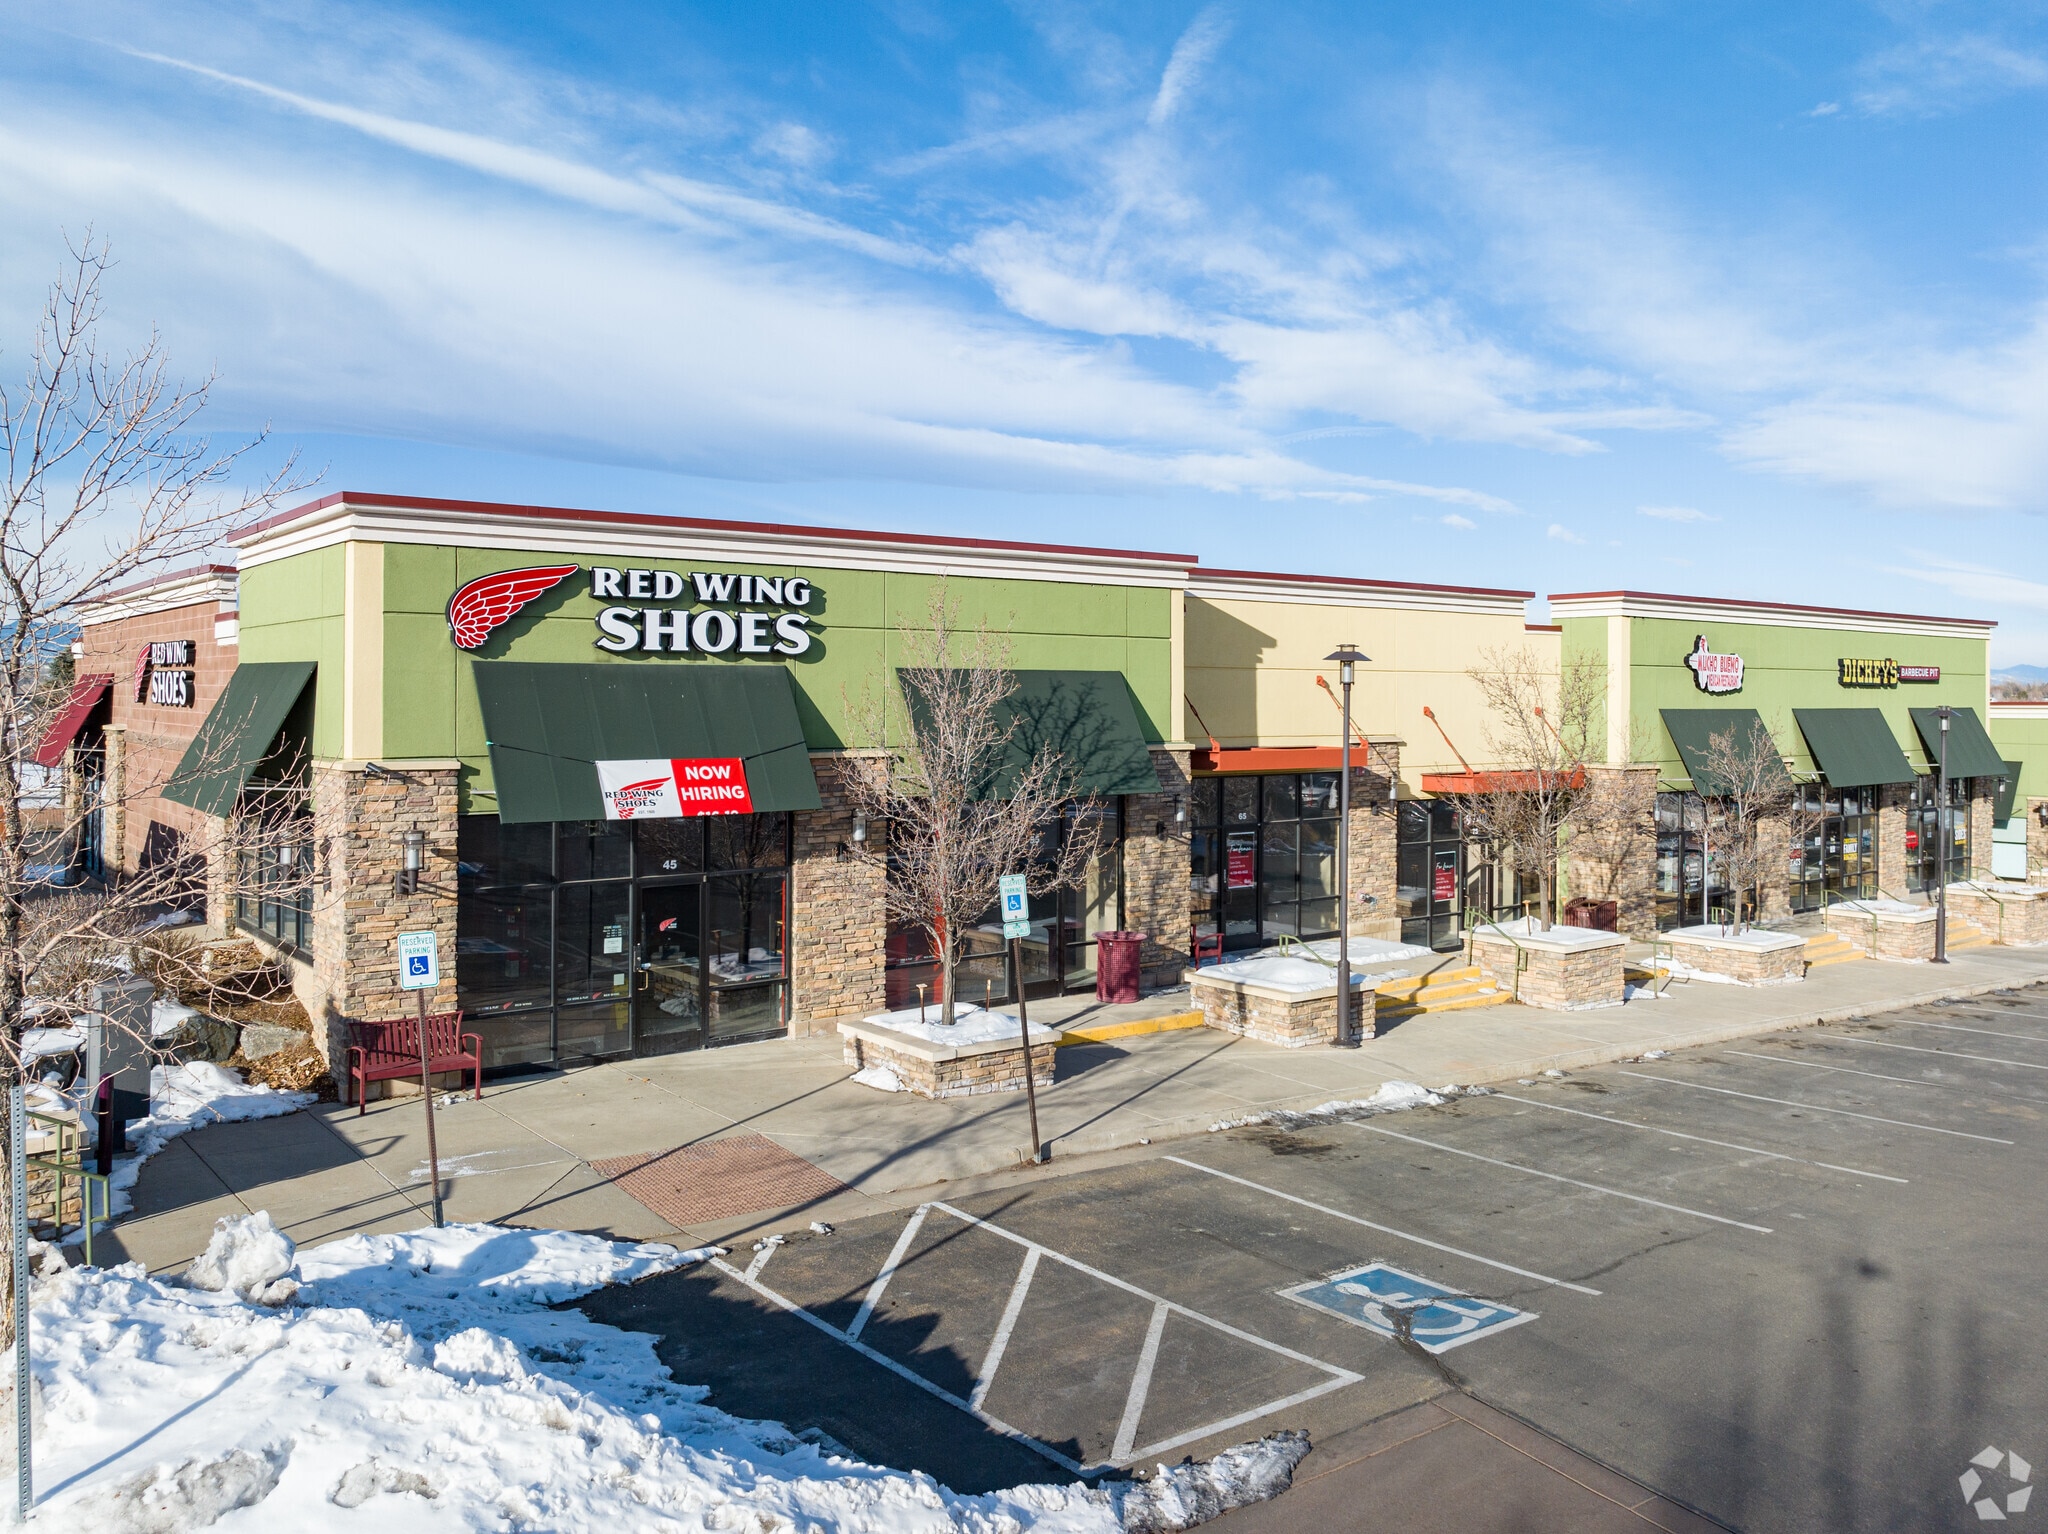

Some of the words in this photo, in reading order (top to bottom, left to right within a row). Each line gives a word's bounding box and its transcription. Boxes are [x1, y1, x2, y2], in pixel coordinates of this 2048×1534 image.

[590, 566, 684, 600] RED
[689, 572, 811, 606] WING
[594, 606, 811, 655] SHOES
[151, 643, 166, 665] RED
[166, 640, 187, 664] WING
[1697, 655, 1718, 672] MUCHO
[1719, 656, 1739, 673] BUENO
[1843, 658, 1898, 684] DICKEY'S
[1901, 667, 1929, 677] BARBECUE
[1929, 668, 1939, 677] PIT
[151, 670, 187, 705] SHOES
[685, 765, 731, 780] NOW
[605, 791, 627, 799] RED
[630, 789, 663, 798] WING
[681, 785, 745, 801] HIRING
[618, 800, 657, 809] SHOES
[1238, 812, 1247, 820] 65
[662, 860, 678, 870] 45
[402, 936, 433, 946] RESERVED
[405, 946, 431, 954] PARKING
